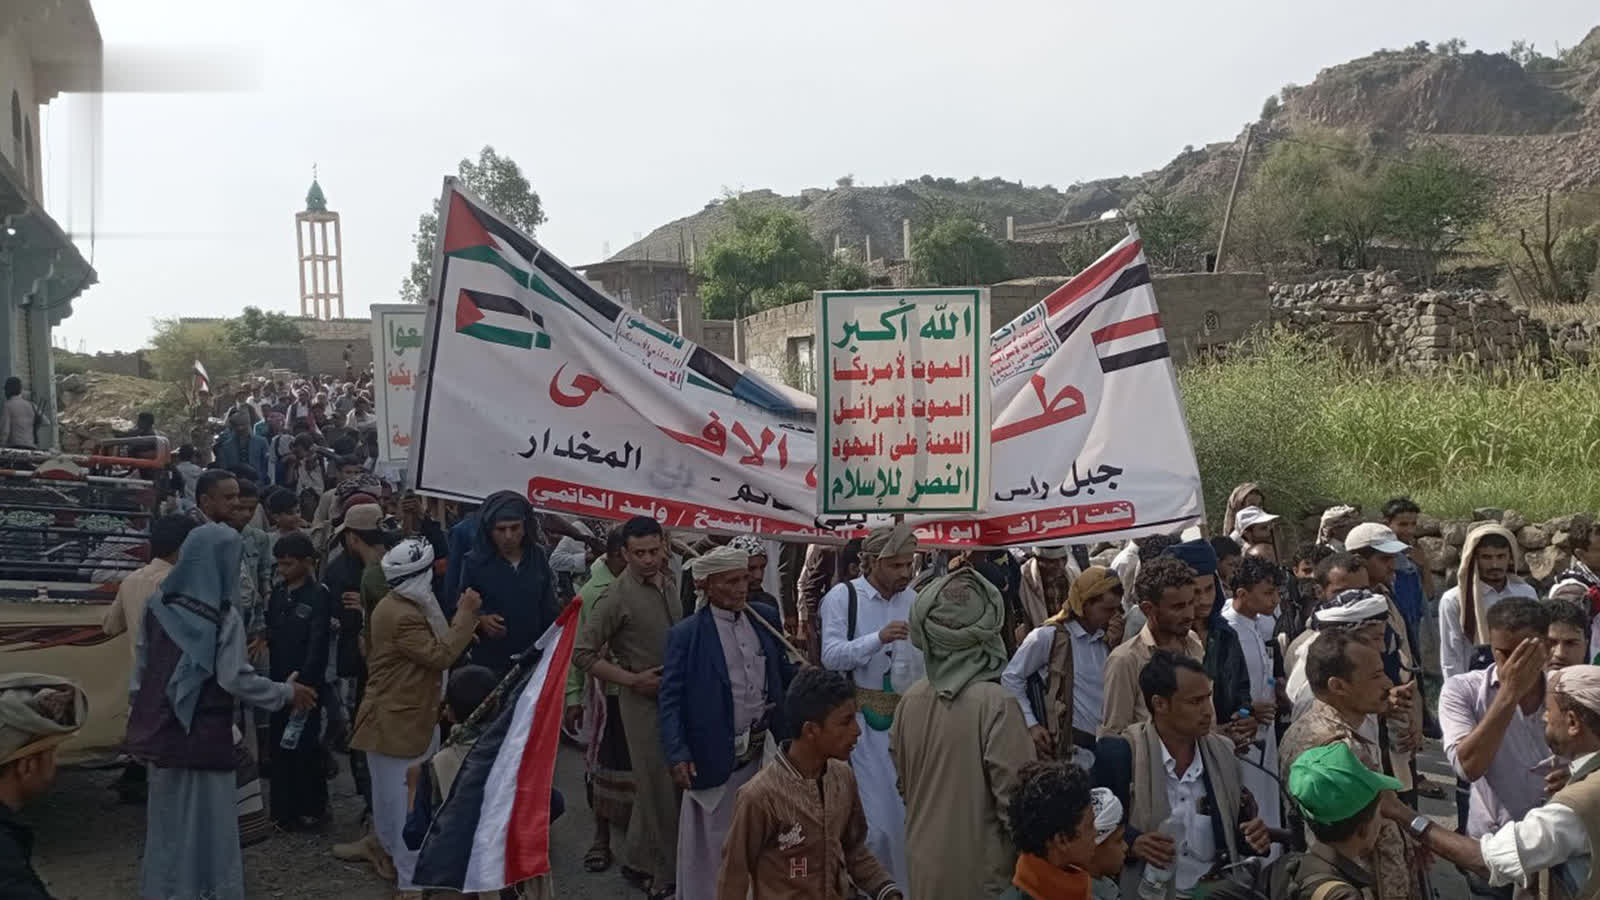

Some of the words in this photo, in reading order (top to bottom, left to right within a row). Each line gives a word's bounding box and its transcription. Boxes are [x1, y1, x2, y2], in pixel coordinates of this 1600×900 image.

[832, 298, 916, 353] أكبر
[920, 303, 972, 340] الله
[912, 353, 970, 384] الموت
[912, 393, 970, 422] الموت
[517, 427, 641, 471] المخدار
[832, 432, 883, 462] اليهود
[925, 431, 970, 455] اللعنة
[832, 467, 902, 507] للإسلام
[907, 463, 970, 503] النصر
[995, 475, 1049, 501] راس
[1060, 460, 1123, 498] جبل
[532, 486, 614, 511] الحاتمي
[619, 500, 668, 523] وليد
[694, 509, 762, 534] الشيخ
[1007, 509, 1079, 536] اشراف
[1084, 502, 1133, 524] تحت
[949, 522, 981, 543] ابو
[790, 857, 808, 879] H
